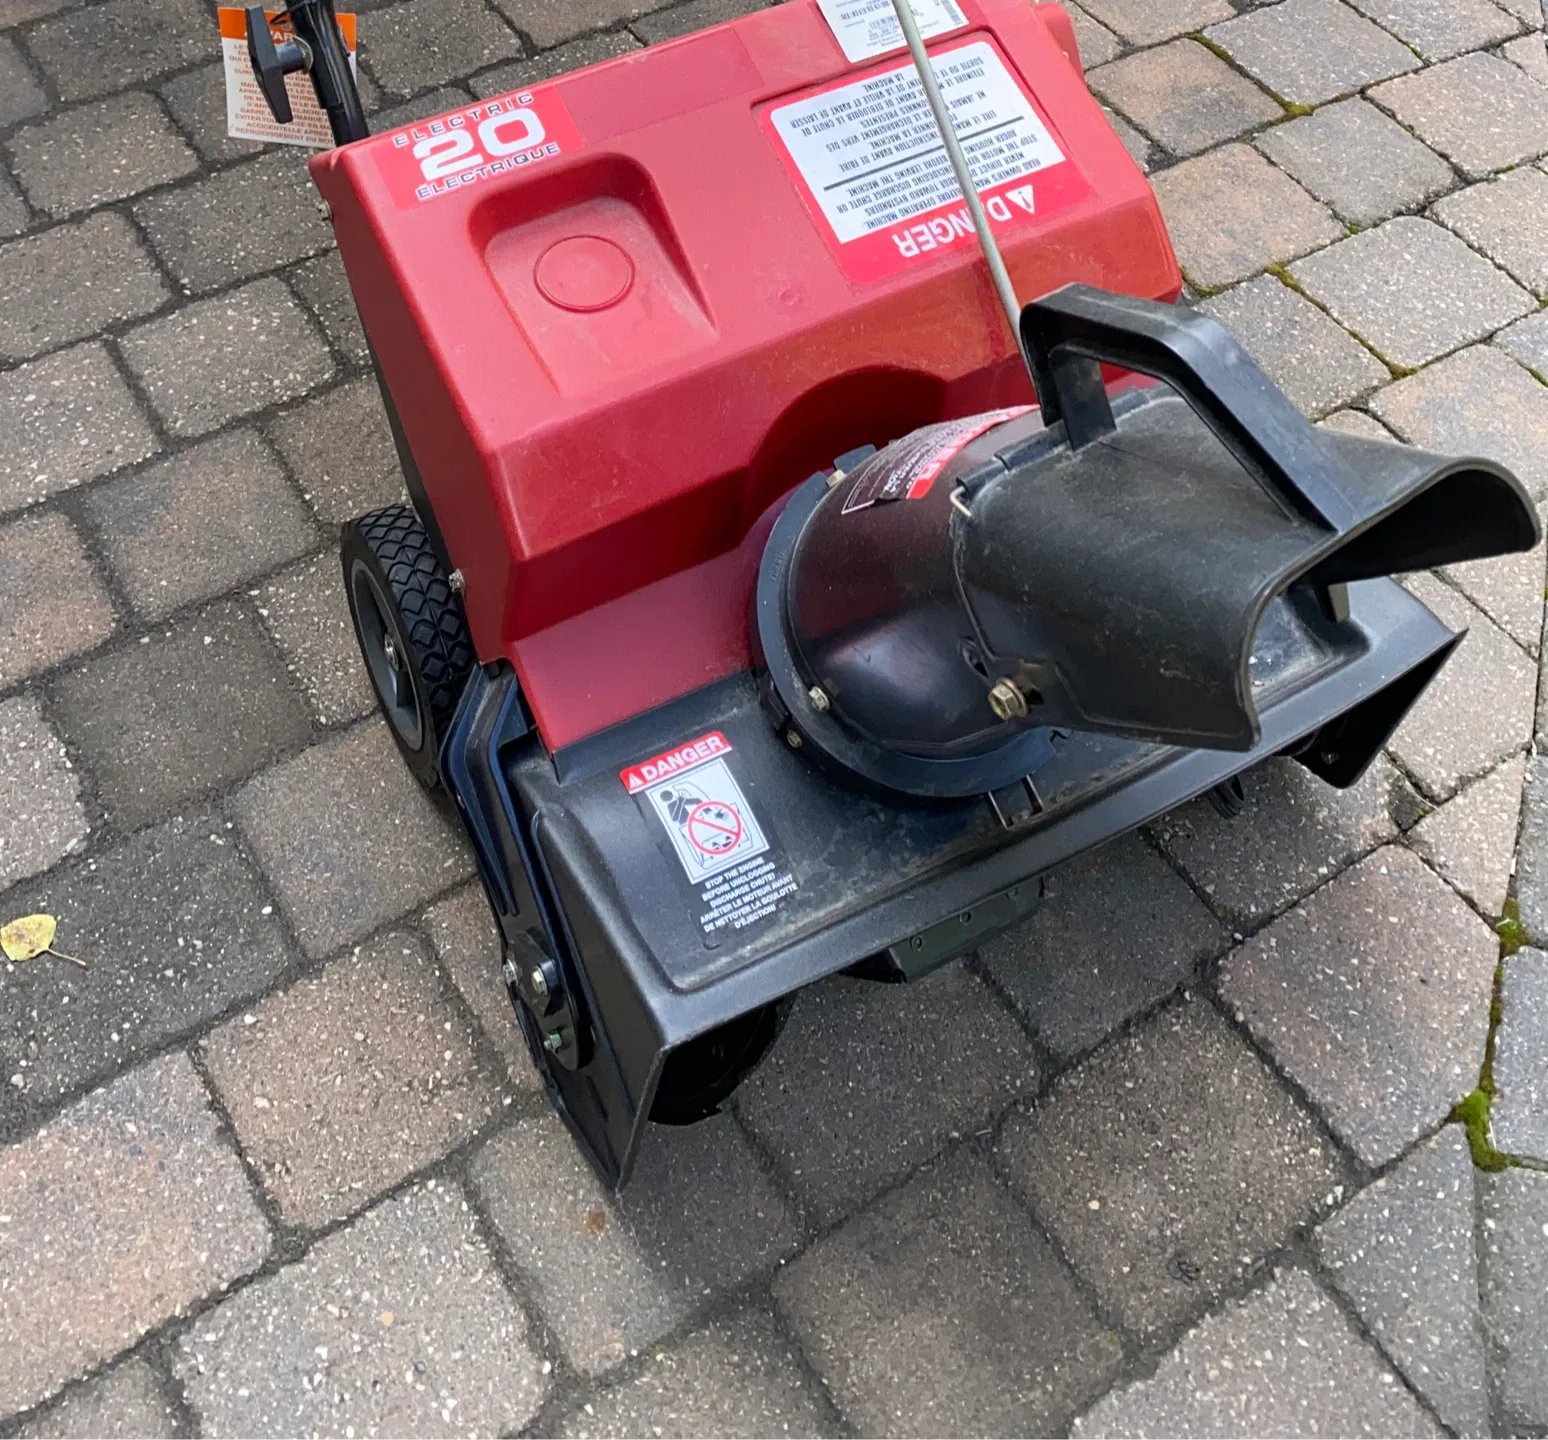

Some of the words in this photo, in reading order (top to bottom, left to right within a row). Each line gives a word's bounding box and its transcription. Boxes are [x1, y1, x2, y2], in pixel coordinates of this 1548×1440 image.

[947, 64, 960, 74] OU
[958, 56, 984, 70] SORTIE
[893, 72, 904, 82] LA
[938, 68, 949, 77] LE
[894, 83, 906, 92] DE
[944, 78, 954, 87] LE
[861, 90, 886, 104] VRILLE
[884, 86, 895, 96] LA
[894, 90, 917, 104] AVANT
[975, 90, 986, 99] NE
[851, 98, 862, 107] ET
[883, 98, 895, 108] DE
[948, 93, 976, 108] JAMAIS
[818, 109, 829, 119] DE
[828, 101, 853, 115] AVANT
[980, 109, 997, 121] LIRE
[393, 92, 534, 148] ELECTRIC
[788, 112, 819, 129] LAISSER
[834, 115, 846, 125] LA
[912, 112, 922, 122] LE
[970, 115, 981, 124] LE
[800, 127, 812, 137] DE
[811, 119, 835, 133] CHUTE
[900, 128, 912, 138] LA
[839, 134, 860, 147] VERS
[993, 128, 1017, 142] AUGER
[1017, 133, 1038, 146] STOP
[412, 107, 546, 181] 20
[824, 141, 841, 152] DES
[962, 137, 995, 154] HOUSING
[1003, 140, 1019, 151] THE
[858, 154, 870, 165] DE
[869, 146, 894, 161] AVANT
[979, 145, 1005, 160] MOTOR
[1002, 150, 1025, 164] NEVER
[837, 158, 860, 172] FAIRE
[921, 154, 948, 169] BEFORE
[977, 159, 1003, 174] DIRECT
[1021, 157, 1042, 170] READ
[893, 163, 923, 180] LEAVING
[878, 173, 894, 185] THE
[871, 180, 912, 200] DISCHARGE
[907, 182, 939, 200] TOWARD
[835, 202, 849, 214] OR
[847, 194, 873, 209] CHUTE
[863, 193, 909, 216] BYSTANDERS
[897, 196, 937, 217] OPERATING
[892, 194, 1012, 258] DNGER
[641, 735, 725, 781] DANGER
[705, 875, 724, 889] STOP
[724, 868, 738, 879] THE
[737, 856, 764, 873] ENGINE
[701, 882, 730, 901] BEFORE
[730, 861, 775, 888] UNCLOGGING
[710, 884, 750, 908] DISCHARGE
[732, 898, 742, 907] LE
[741, 884, 771, 903] MOTEUR
[770, 873, 793, 889] AVANT
[703, 922, 715, 932] DE
[714, 905, 751, 927] NETTOYER
[750, 900, 761, 909] LA
[760, 882, 798, 905] GOULOTTE
